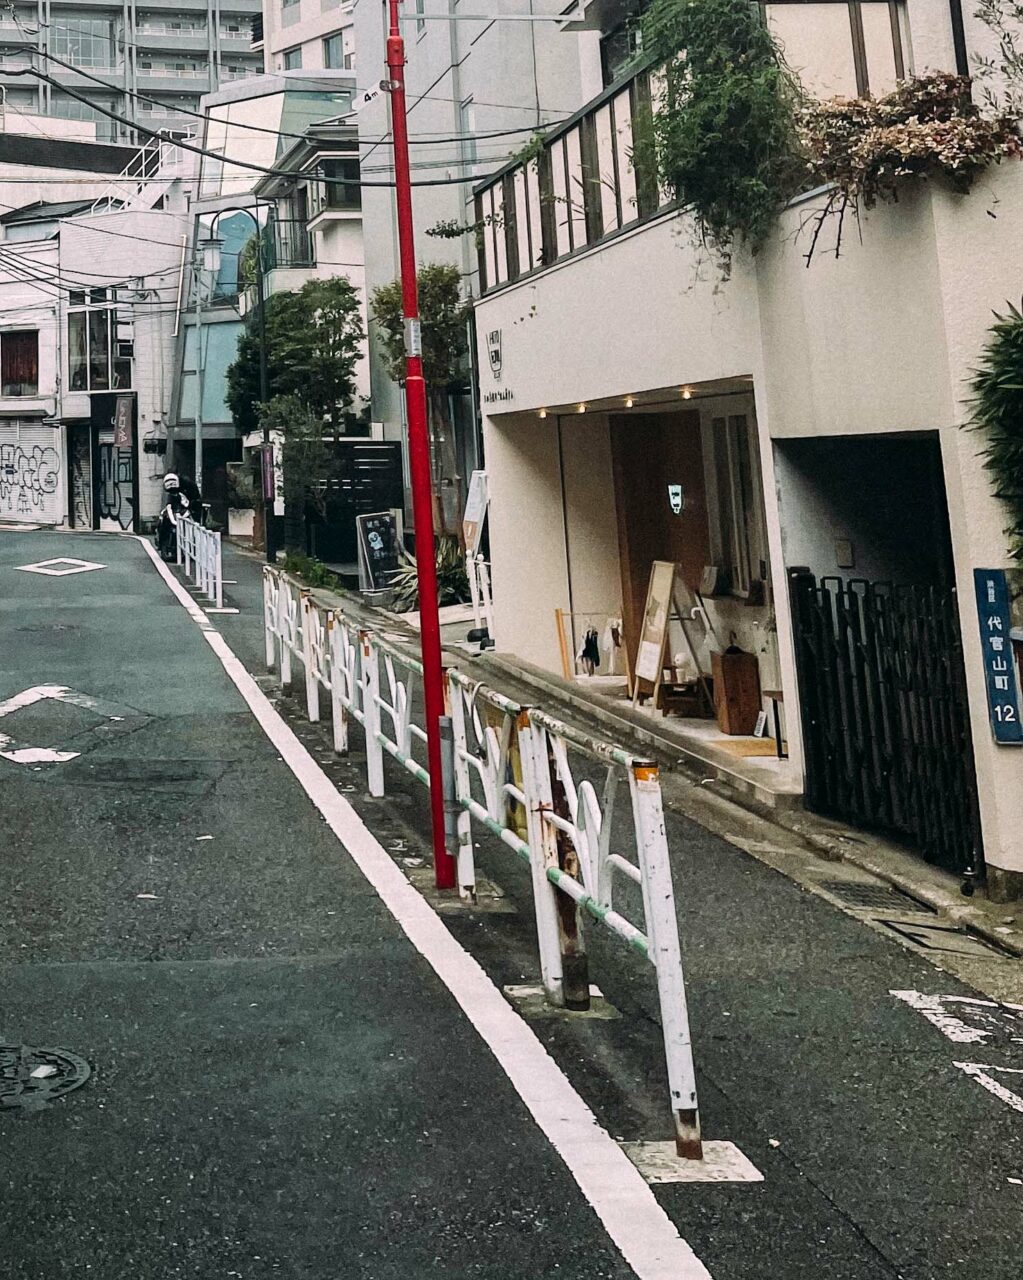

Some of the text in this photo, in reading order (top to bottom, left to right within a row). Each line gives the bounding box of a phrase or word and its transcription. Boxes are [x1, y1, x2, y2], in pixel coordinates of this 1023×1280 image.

[987, 616, 1009, 691] 代官山町
[994, 704, 1016, 722] 12
